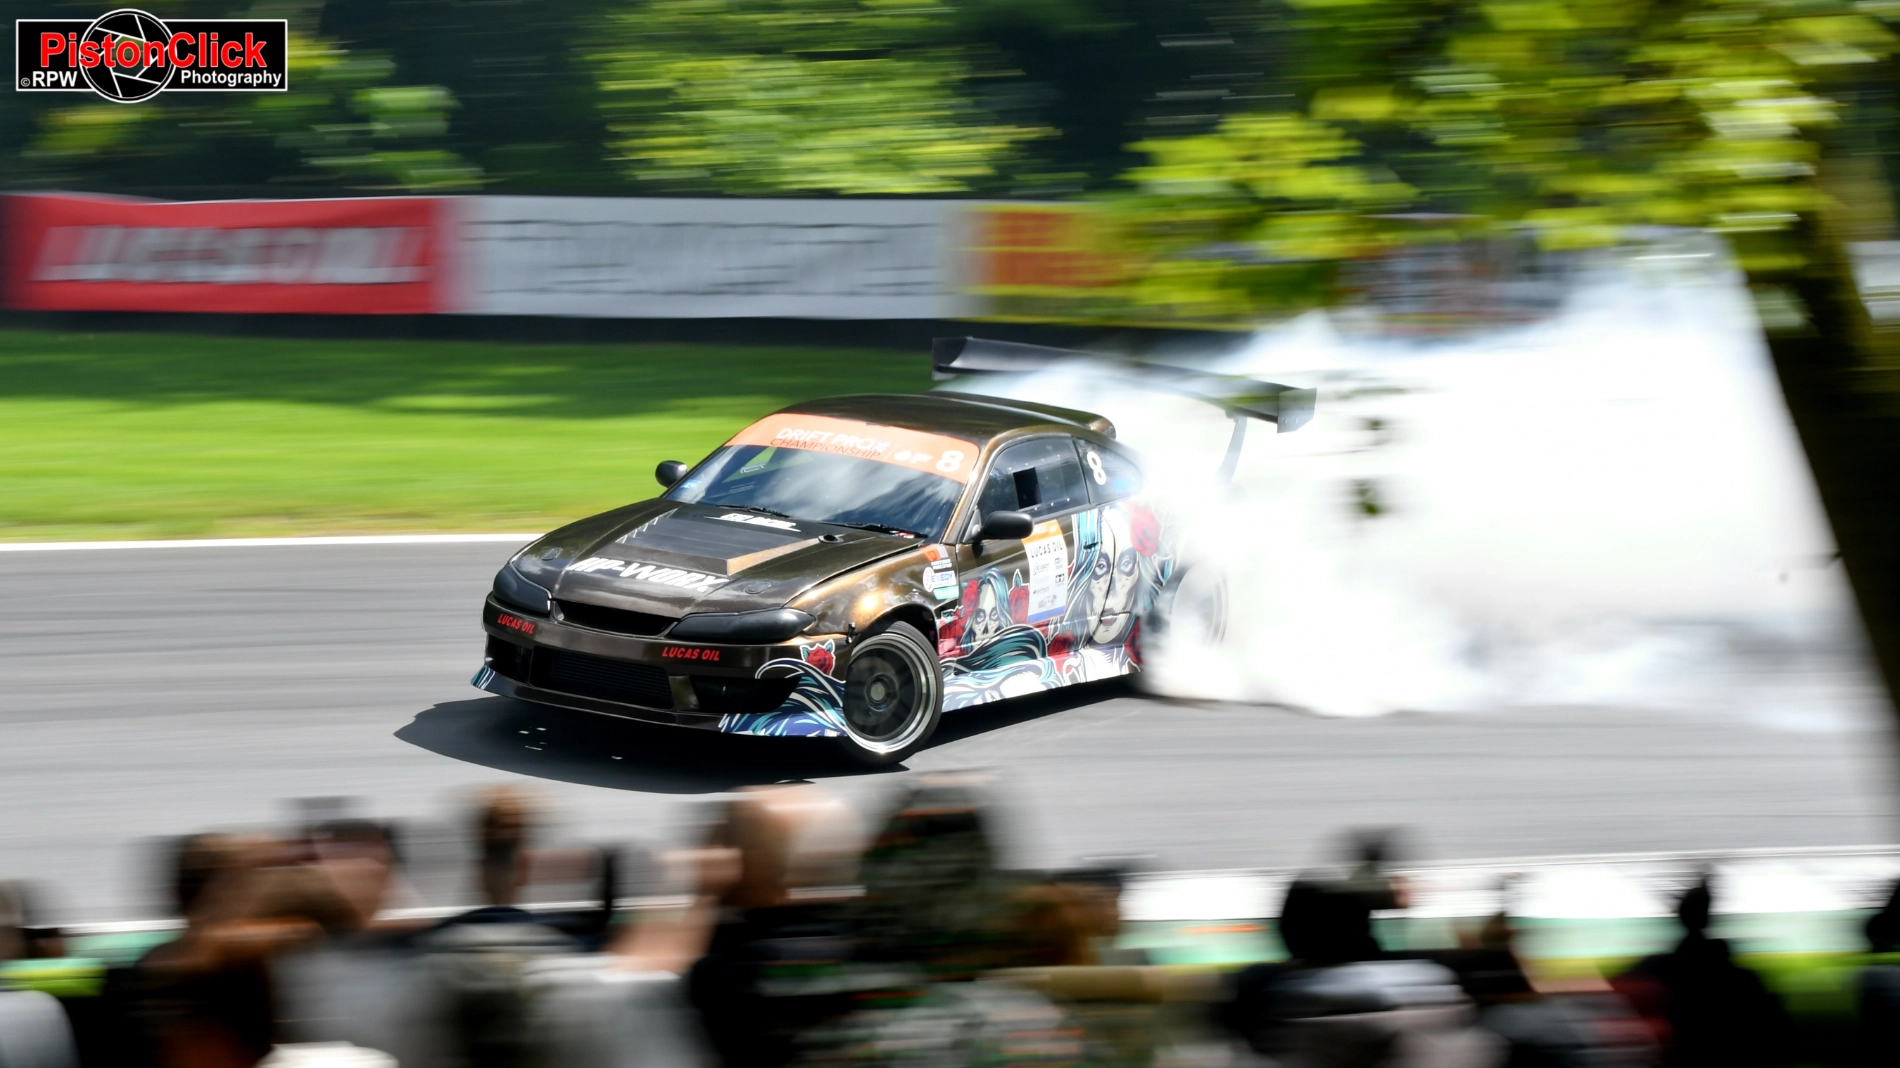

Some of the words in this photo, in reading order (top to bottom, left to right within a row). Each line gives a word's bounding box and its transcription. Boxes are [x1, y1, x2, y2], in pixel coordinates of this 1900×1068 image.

[775, 427, 834, 443] DRIFT
[770, 439, 881, 458] CHAMPIONSHIP
[935, 450, 965, 472] 8
[1087, 451, 1107, 485] 8
[1030, 544, 1051, 558] LUCAS
[1052, 541, 1063, 552] OIL
[497, 613, 523, 629] LUCAS
[521, 621, 536, 635] OIL
[662, 646, 700, 659] LUCAS
[701, 649, 720, 661] OIL
